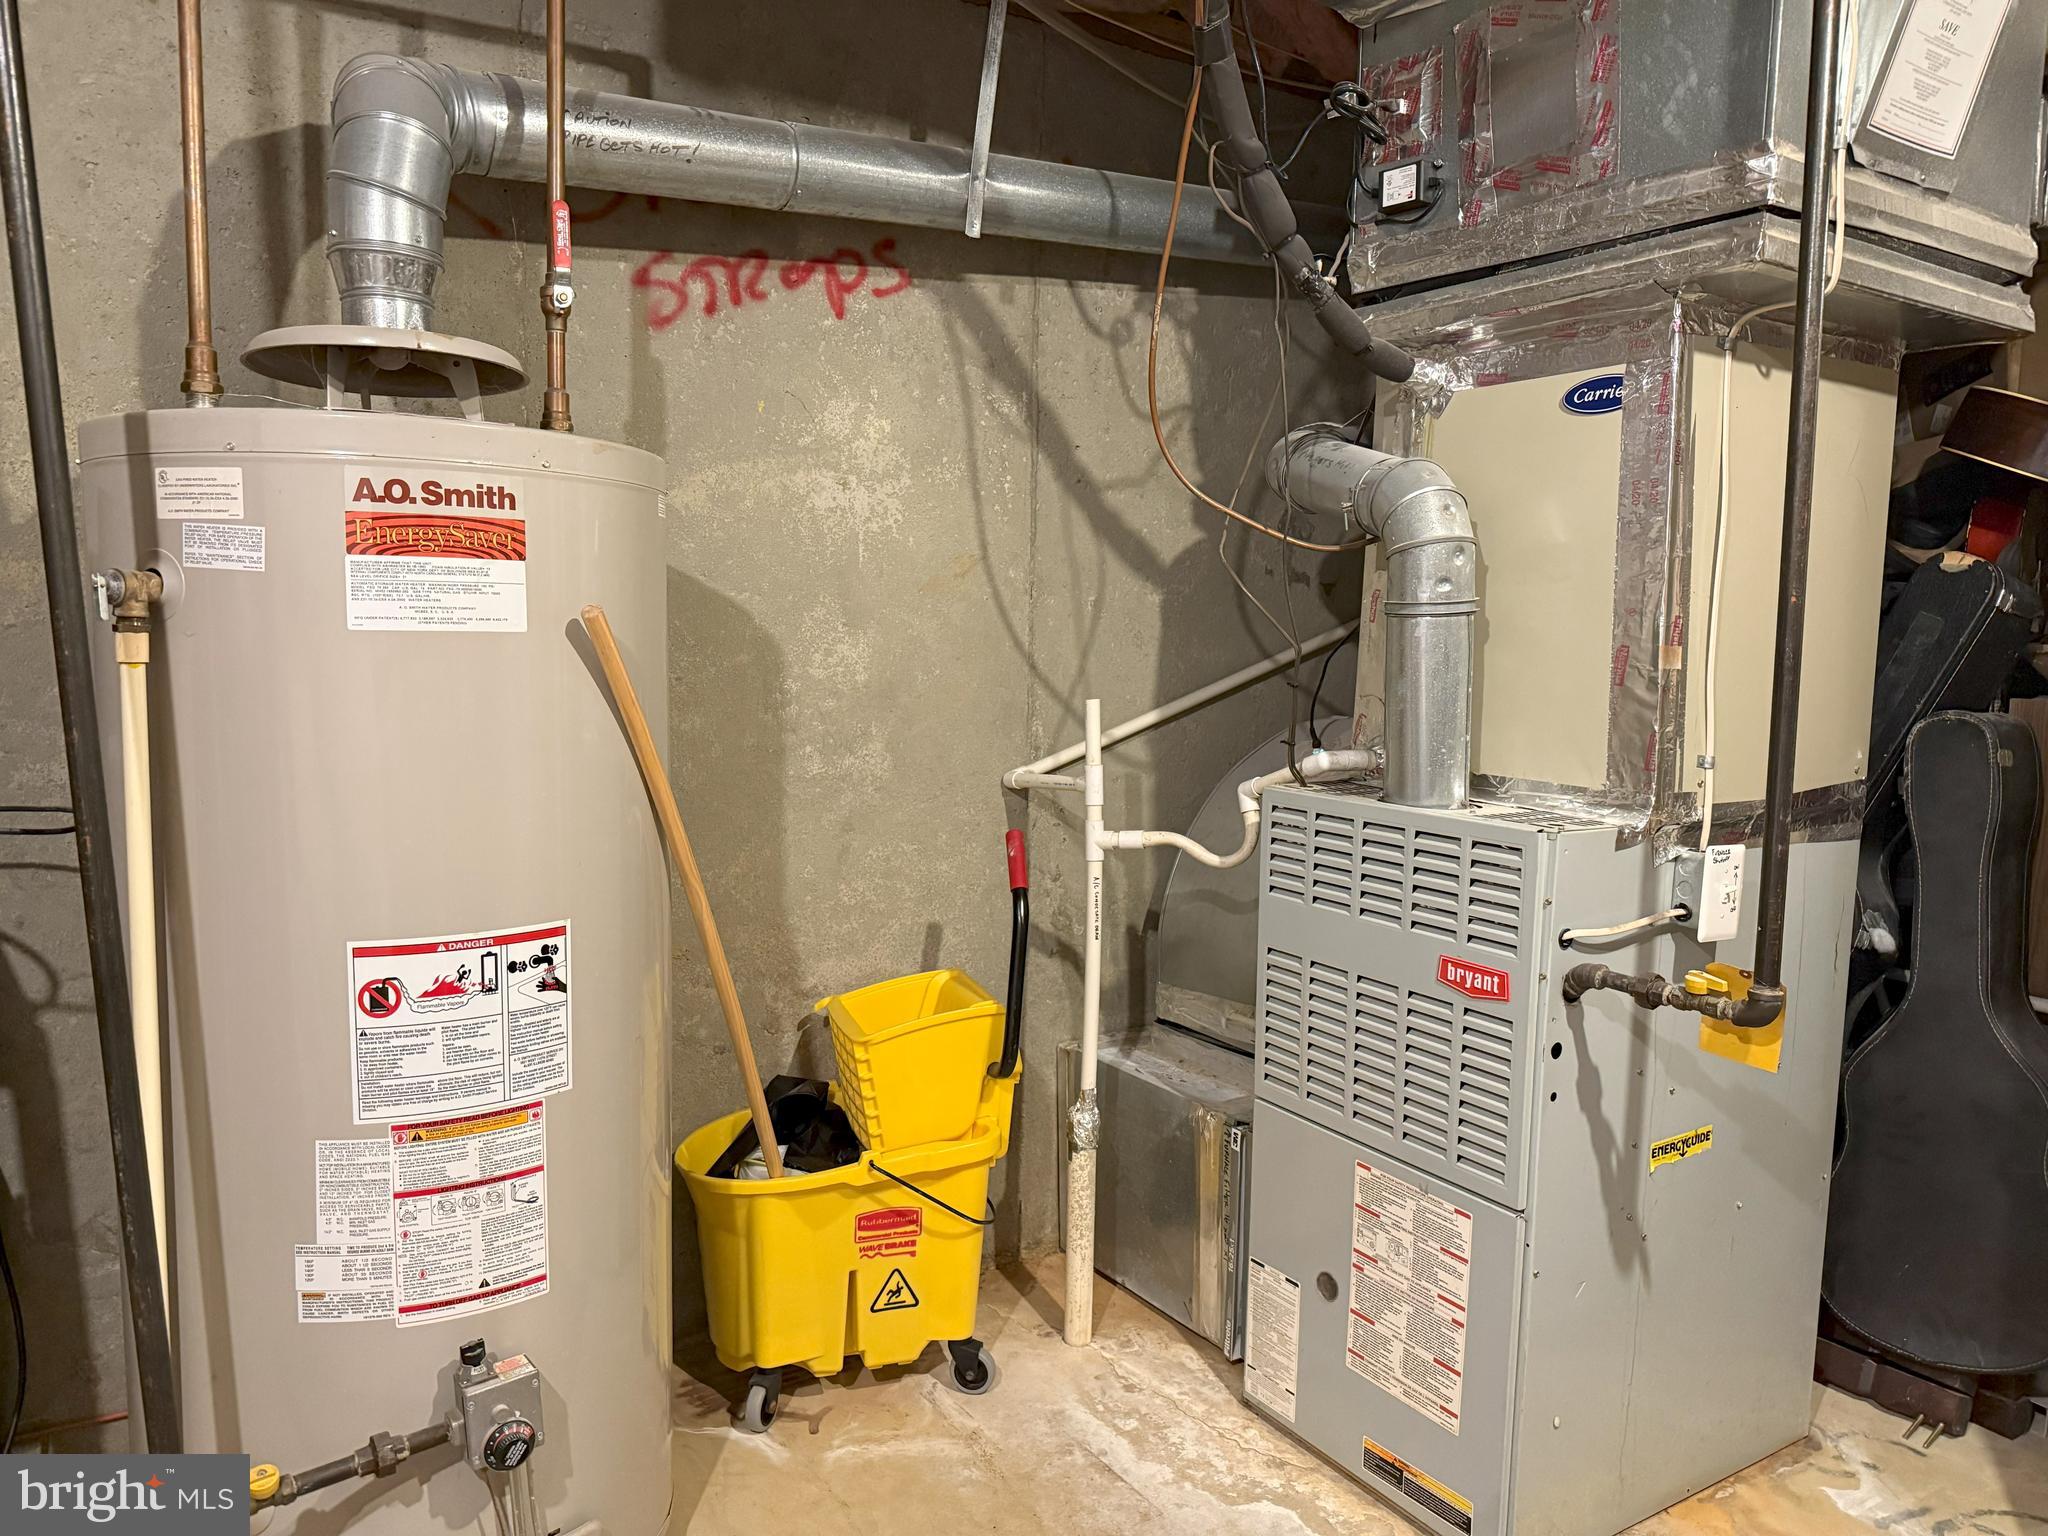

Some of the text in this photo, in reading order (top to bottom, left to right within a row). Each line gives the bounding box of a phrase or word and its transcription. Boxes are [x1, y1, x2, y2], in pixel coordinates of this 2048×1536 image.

[1938, 18, 1961, 37] SAVE
[1573, 384, 1624, 404] Carrie
[352, 478, 517, 511] A.O. Smith
[448, 938, 494, 950] DANGER
[1447, 962, 1500, 994] bryant
[416, 1002, 446, 1010] Flammable
[1651, 1130, 1712, 1159] ENERGYGUIDE
[860, 1214, 917, 1226] Rubbermaid
[859, 1239, 916, 1254] WAVE BRAKE
